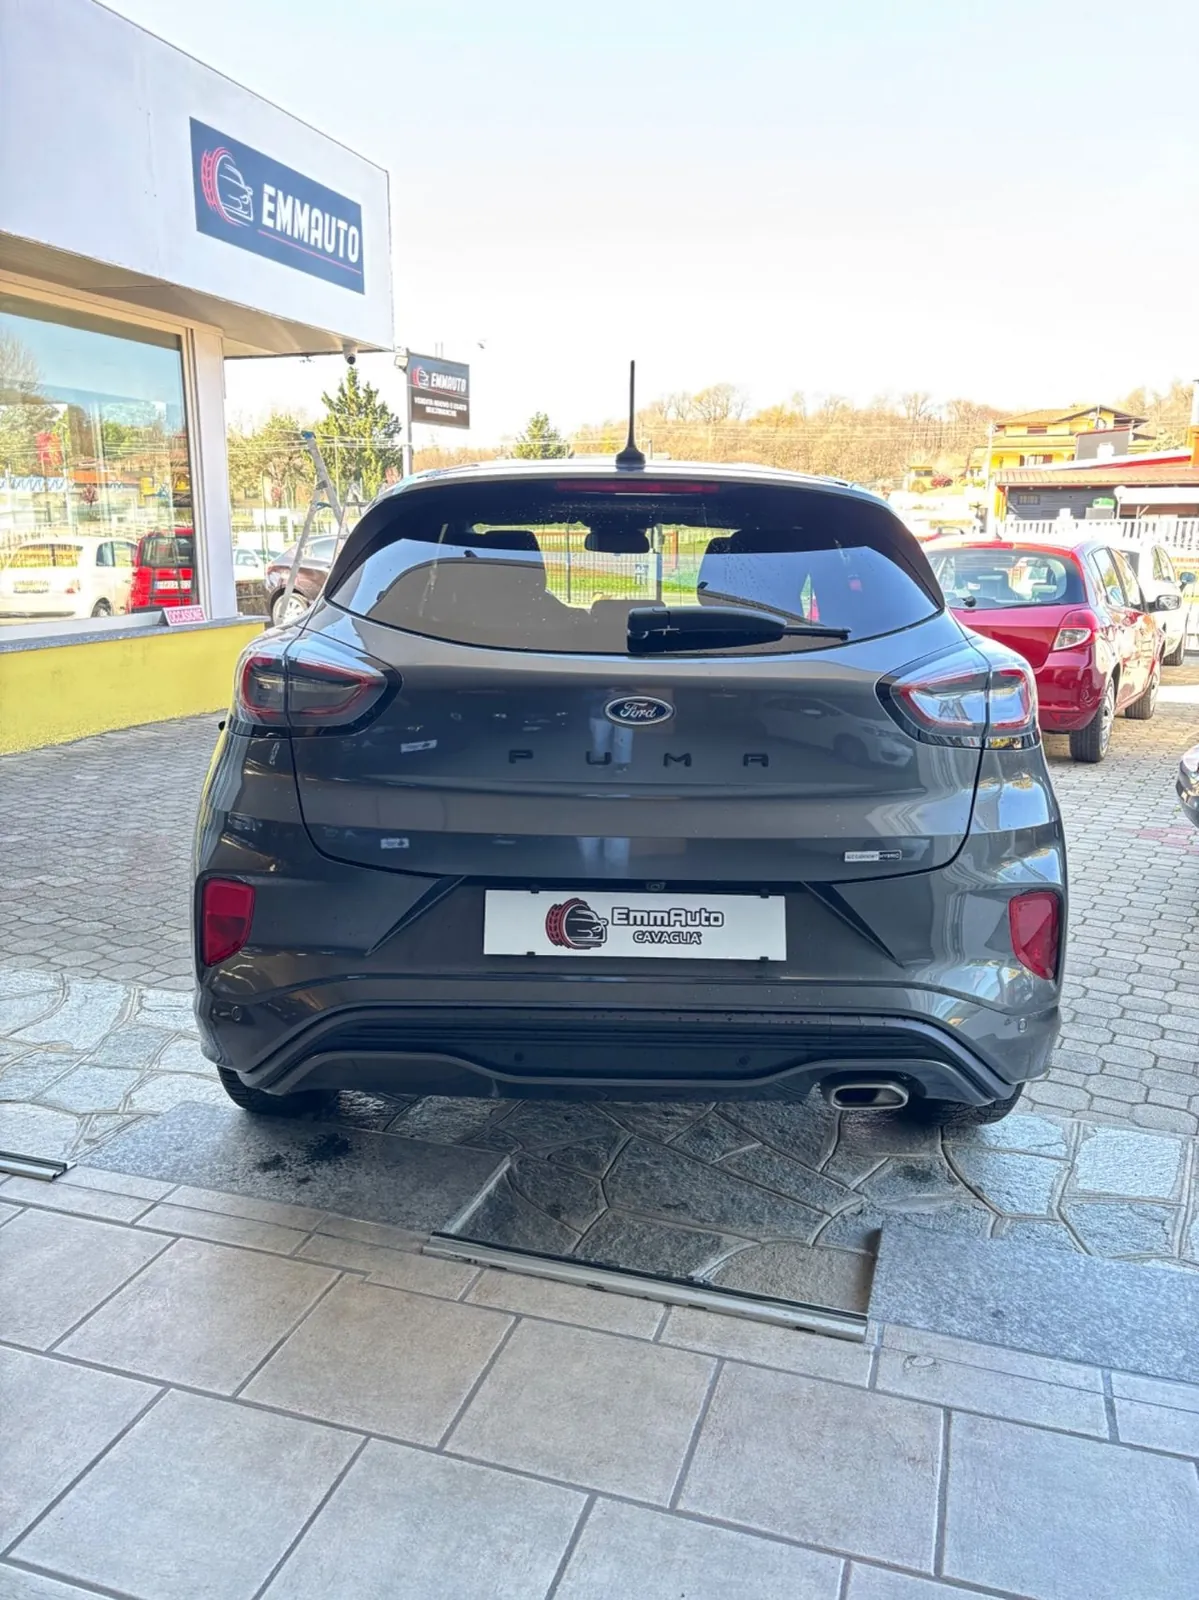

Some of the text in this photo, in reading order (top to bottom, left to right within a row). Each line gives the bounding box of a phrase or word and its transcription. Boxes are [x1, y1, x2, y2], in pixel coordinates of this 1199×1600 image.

[262, 183, 360, 263] EMMAUTO
[431, 372, 467, 392] EMMAUTO
[620, 701, 657, 718] Ford
[508, 750, 769, 768] PUMA
[611, 907, 724, 927] EmmAuto
